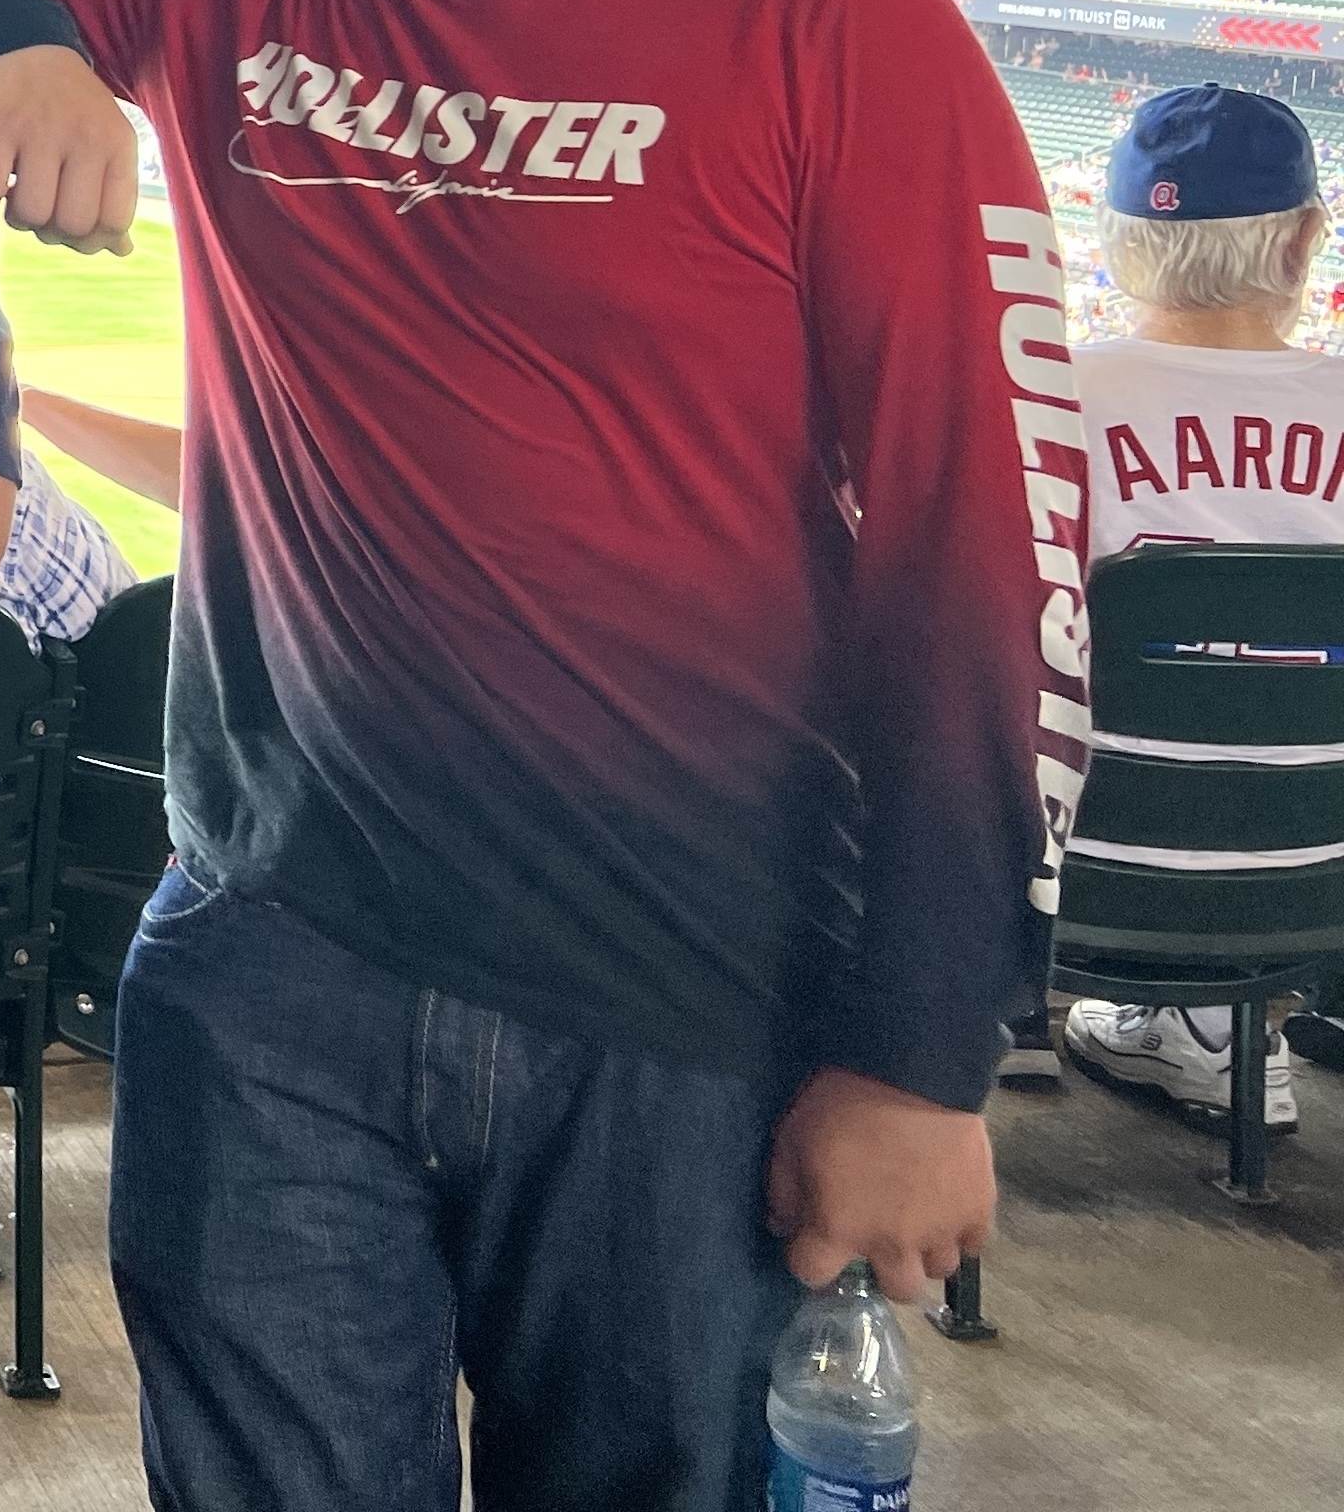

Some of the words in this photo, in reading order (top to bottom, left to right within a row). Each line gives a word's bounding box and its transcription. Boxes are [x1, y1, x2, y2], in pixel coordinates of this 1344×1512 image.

[1048, 7, 1062, 19] TO
[1068, 7, 1113, 25] TRUIST
[1132, 15, 1167, 31] PARK
[237, 41, 666, 185] HOLLISTER
